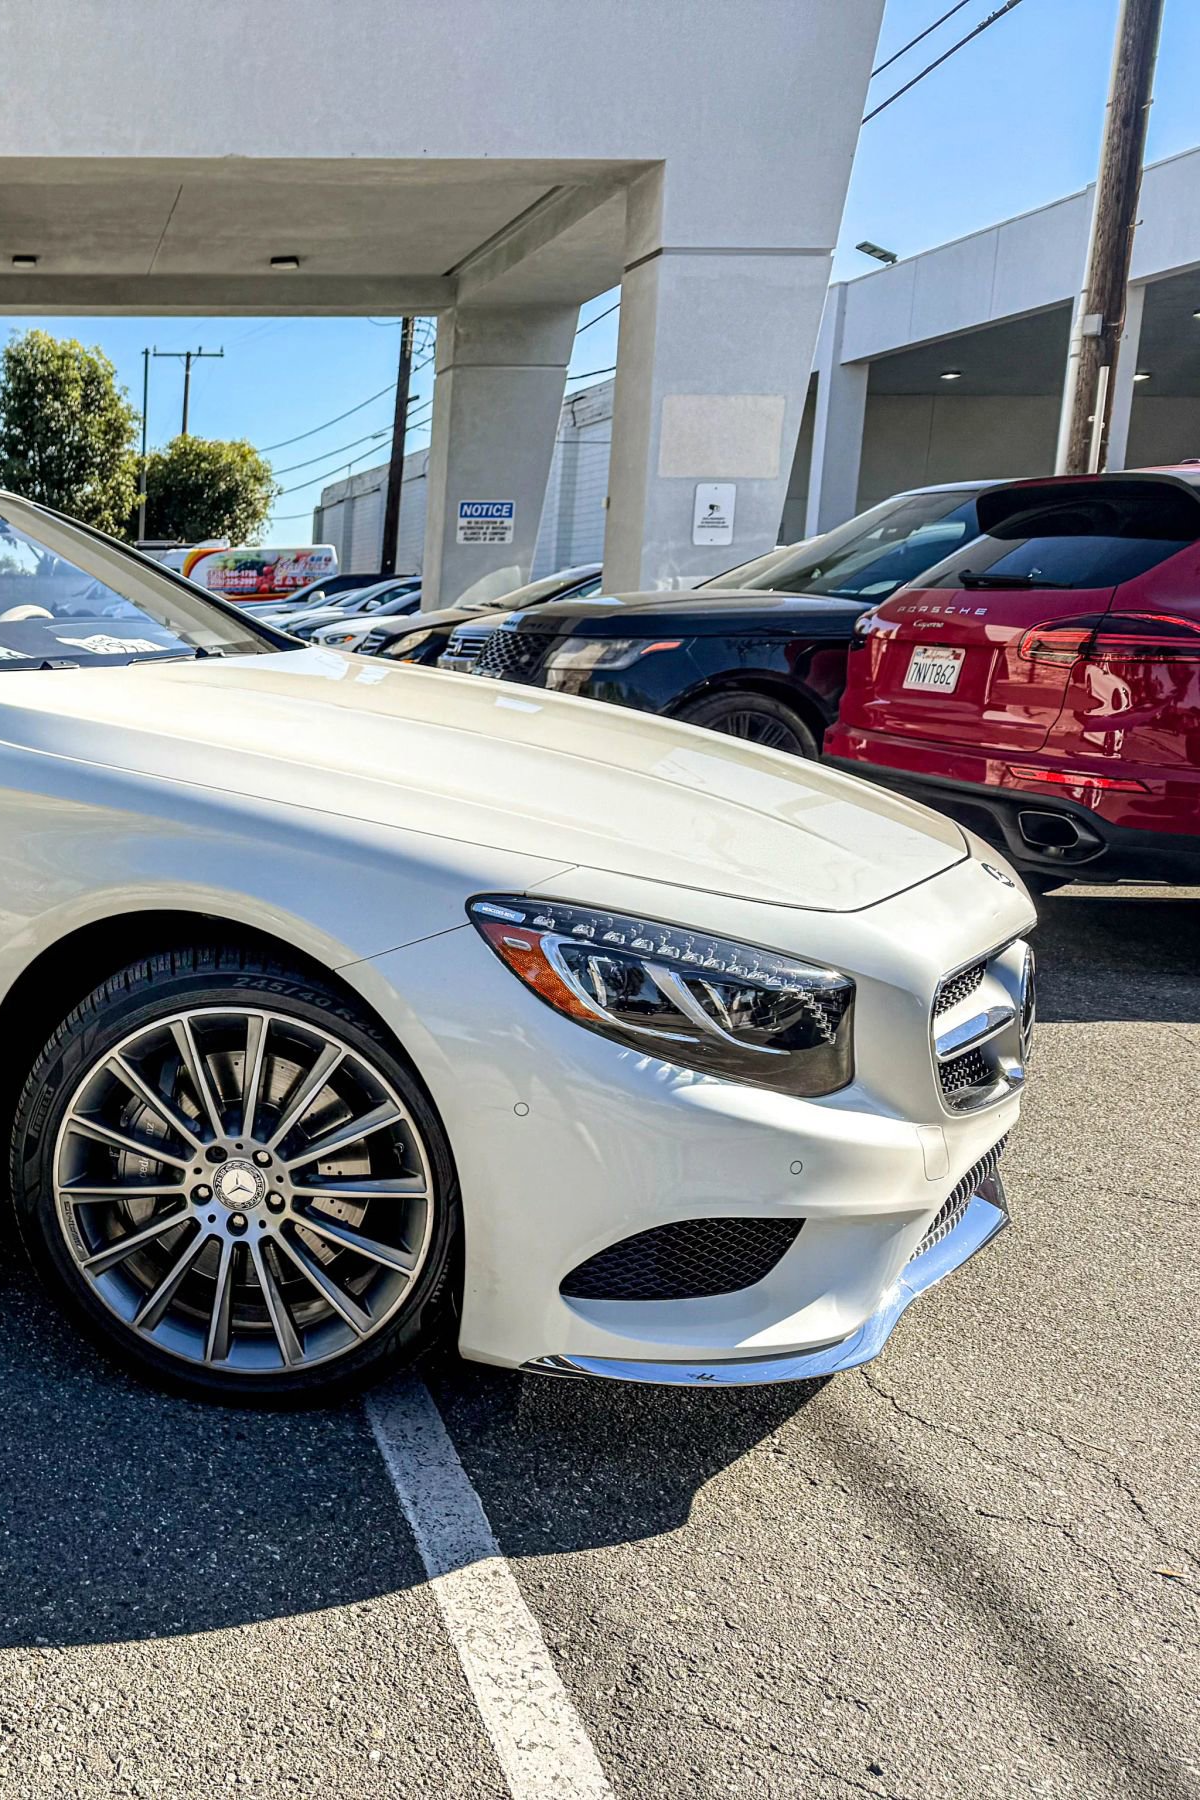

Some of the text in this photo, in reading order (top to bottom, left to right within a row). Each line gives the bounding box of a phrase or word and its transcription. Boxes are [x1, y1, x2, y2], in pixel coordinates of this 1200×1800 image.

[461, 504, 511, 516] NOTICE
[897, 606, 988, 615] PORSCHE
[913, 619, 944, 630] Cayenne
[911, 662, 955, 685] 7NVT862
[232, 977, 332, 1007] 245/40
